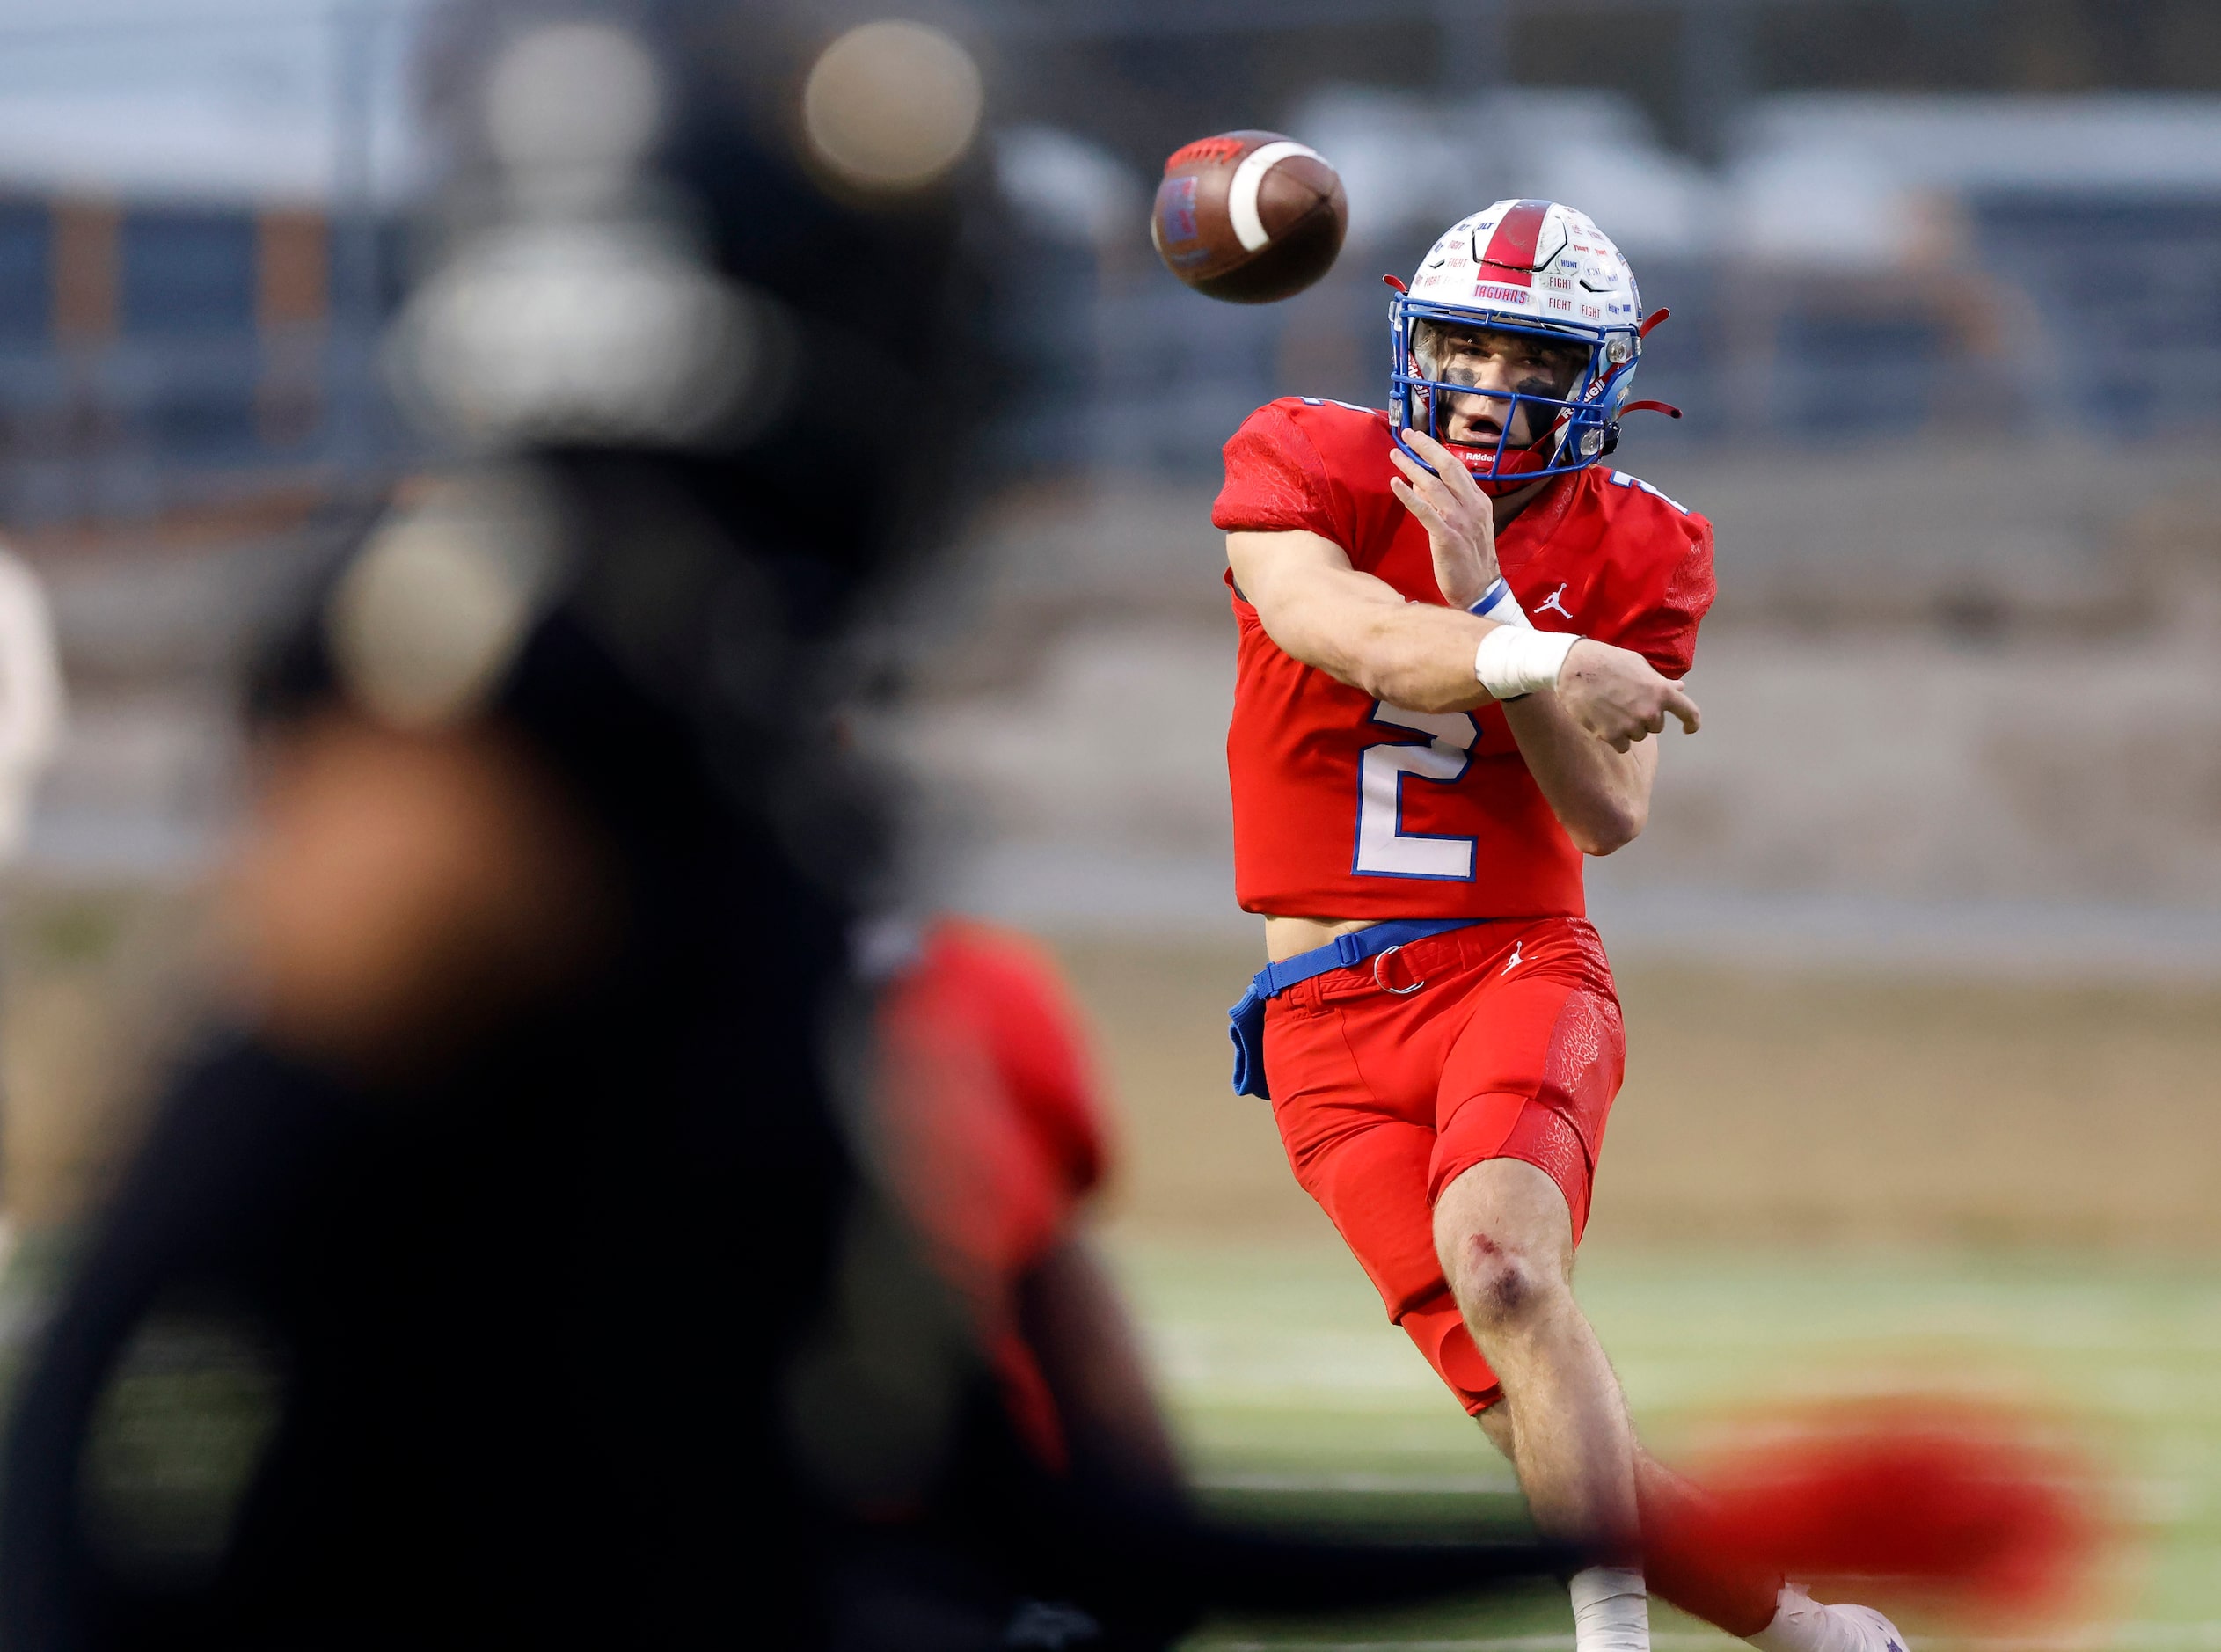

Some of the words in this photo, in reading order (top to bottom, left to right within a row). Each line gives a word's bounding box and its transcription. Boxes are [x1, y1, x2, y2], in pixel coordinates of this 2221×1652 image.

[1447, 258, 1468, 268] FIGHT
[1560, 259, 1578, 269] HUNT
[1549, 276, 1572, 289] FIGHT
[1472, 284, 1528, 305] JAGUARS
[1548, 297, 1572, 311] FIGHT
[1582, 304, 1601, 319] FIGHT
[1351, 698, 1482, 882] 2
